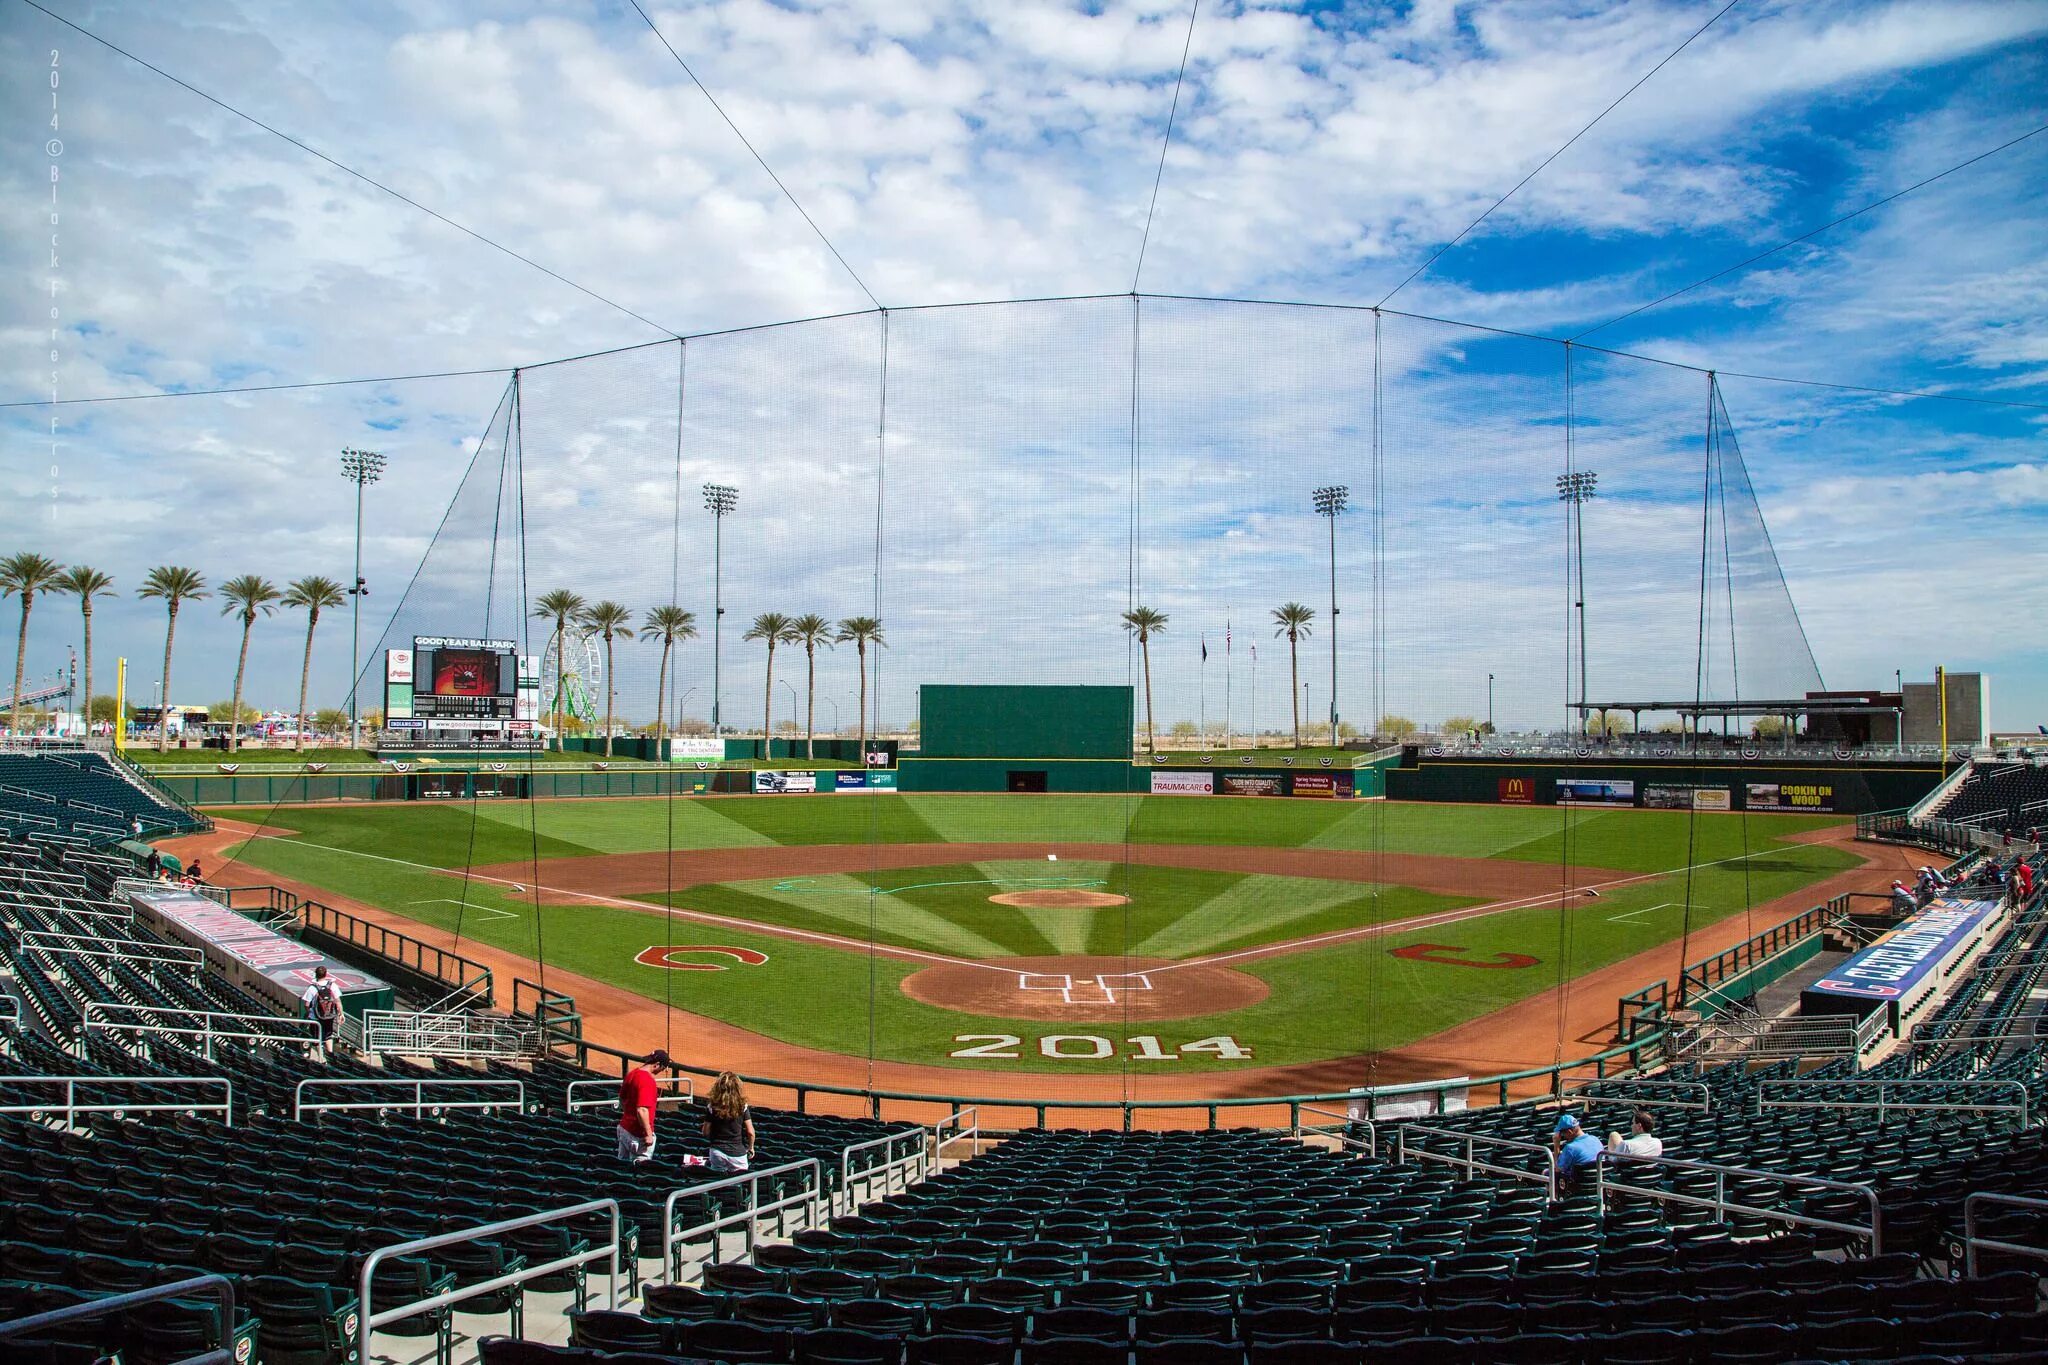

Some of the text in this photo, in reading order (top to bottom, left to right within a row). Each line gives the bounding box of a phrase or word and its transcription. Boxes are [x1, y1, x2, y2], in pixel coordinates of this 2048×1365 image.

[415, 637, 516, 649] GOODYEAR BALLPARK
[1153, 782, 1204, 791] TRAUMACARE
[1780, 785, 1832, 796] COOKIN ON
[1791, 795, 1821, 806] WOOD
[1746, 804, 1833, 812] www.cookinonwood.com
[1844, 933, 1945, 981] CLEVELAND
[1902, 909, 1972, 936] INDIANS
[948, 1034, 1252, 1060] 2014
